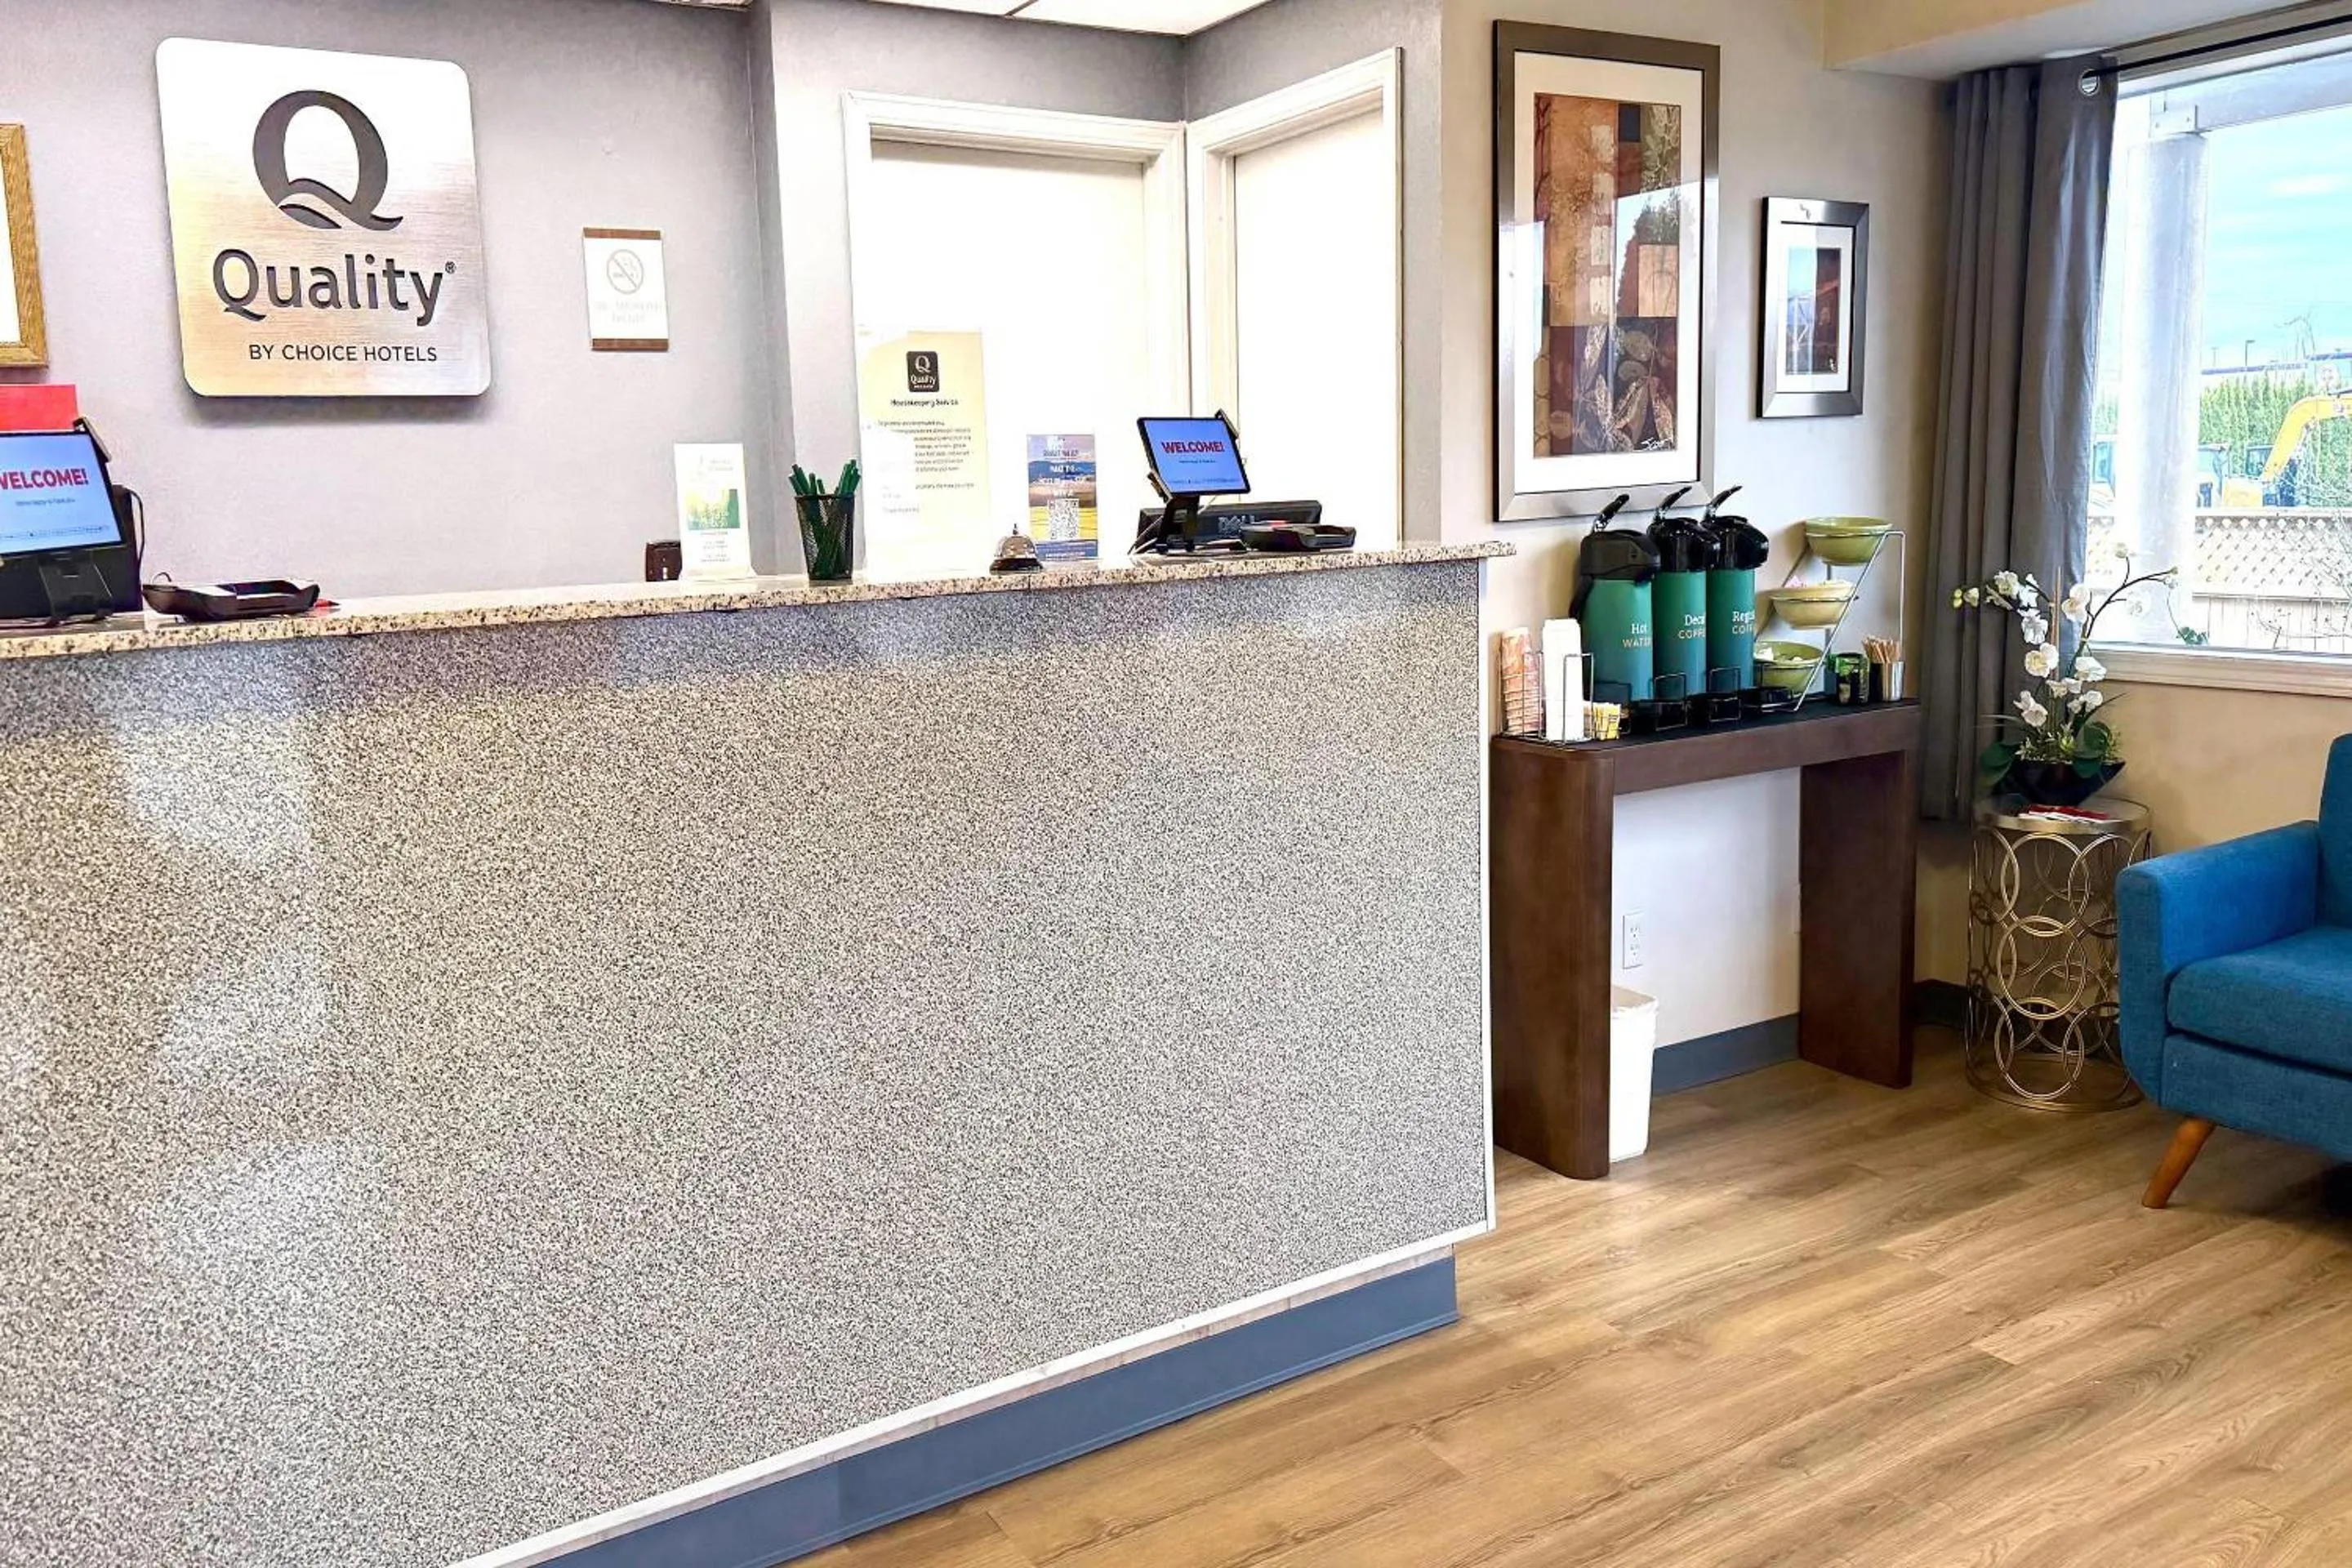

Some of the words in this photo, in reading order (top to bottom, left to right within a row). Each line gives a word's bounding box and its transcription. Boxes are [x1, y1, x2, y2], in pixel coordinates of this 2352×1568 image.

[252, 90, 403, 231] Q
[249, 345, 275, 360] BY
[282, 345, 358, 361] CHOICE
[364, 345, 438, 362] HOTELS
[1161, 441, 1225, 453] WELCOME!
